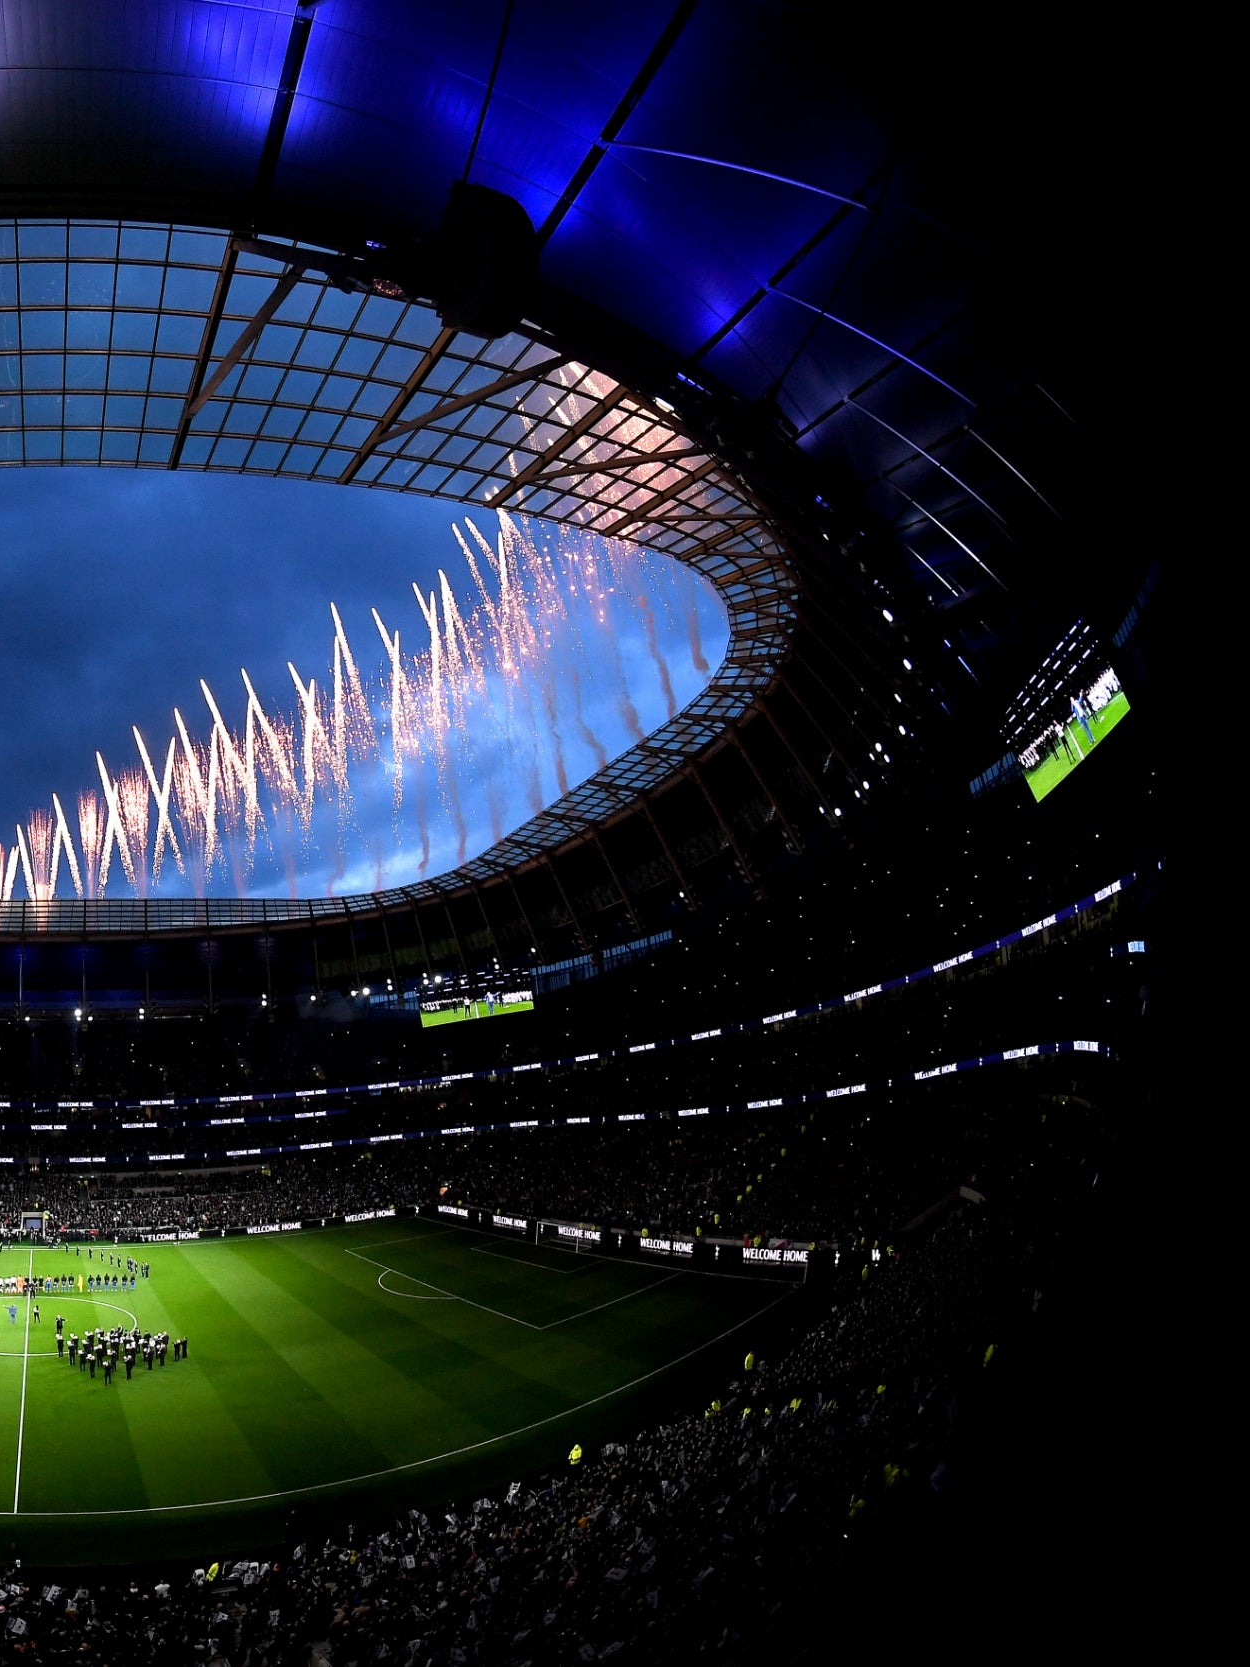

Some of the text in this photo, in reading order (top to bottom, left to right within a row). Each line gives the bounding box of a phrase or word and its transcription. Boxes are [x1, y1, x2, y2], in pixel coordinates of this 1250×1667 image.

[933, 951, 973, 972] WELCOME HOME
[844, 984, 882, 1002] WELCOME HOME
[763, 1010, 797, 1024] WELCOME HOME
[942, 1063, 957, 1074] HOME
[827, 1084, 866, 1097] WELCOME HOME
[747, 1101, 768, 1109] WELCOME
[345, 1209, 396, 1222] WELCOME HOME
[493, 1215, 527, 1229] WELCOME HOME
[247, 1222, 301, 1234] WELCOME HOME
[558, 1225, 601, 1241] WELCOME HOME
[178, 1232, 200, 1240] HOME
[673, 1241, 694, 1253] HOME
[743, 1247, 808, 1262] WELCOME HOME
